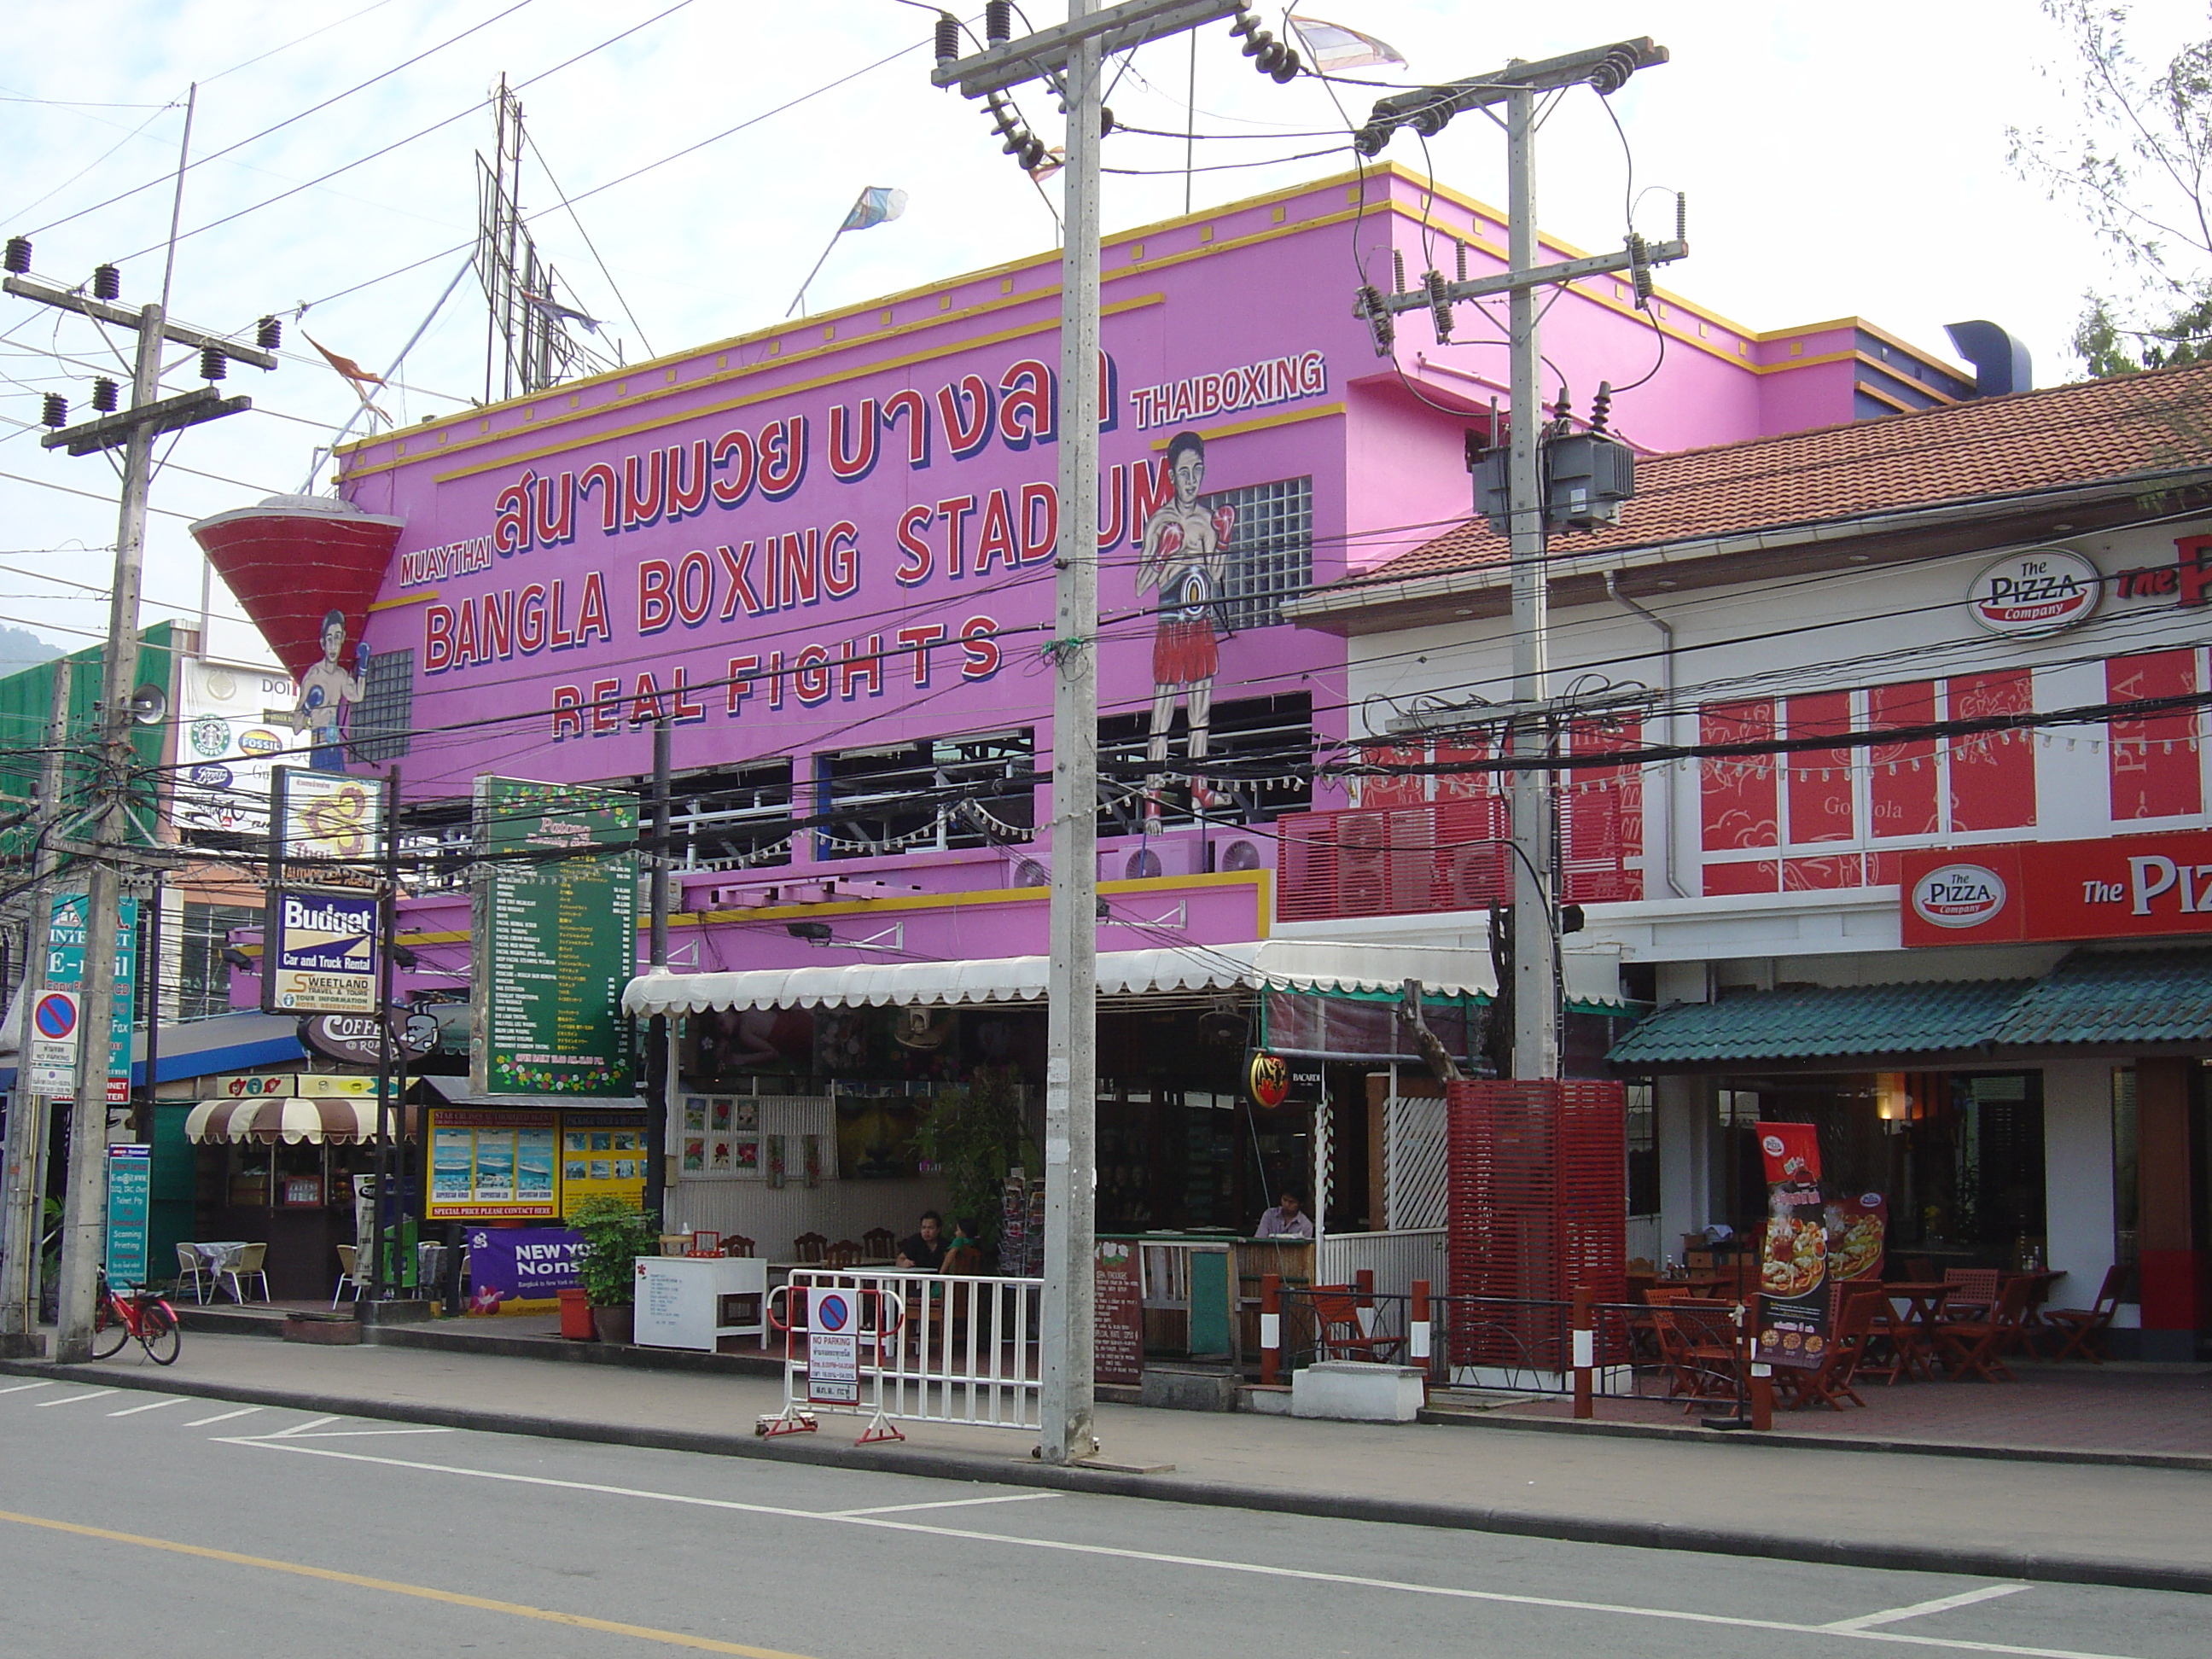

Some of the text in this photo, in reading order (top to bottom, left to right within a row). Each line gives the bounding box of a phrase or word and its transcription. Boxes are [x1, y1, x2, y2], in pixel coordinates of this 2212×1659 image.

[1130, 349, 1328, 432] THAIBOXING
[492, 415, 806, 556] สนามมวย
[424, 456, 1176, 675] BANGLA BOXING STADUM
[2021, 562, 2047, 577] The
[1991, 574, 2079, 606] PIZZA
[2005, 602, 2064, 620] Company
[552, 614, 1004, 740] REAL FIGHTS
[242, 736, 282, 751] FOSSIL
[1824, 796, 1903, 819] Goola
[1952, 873, 1970, 884] The
[1930, 882, 1992, 903] PIZZA
[2082, 880, 2123, 904] The
[1939, 903, 1981, 915] Company
[285, 900, 374, 937] Budget
[283, 953, 370, 971] Car and Truck Rental
[286, 974, 369, 992] SWEETLAND
[318, 995, 368, 1004] INFORMATION
[114, 1241, 140, 1252] Printing
[515, 1244, 561, 1260] NEW
[812, 1336, 851, 1347] NO PARKING
